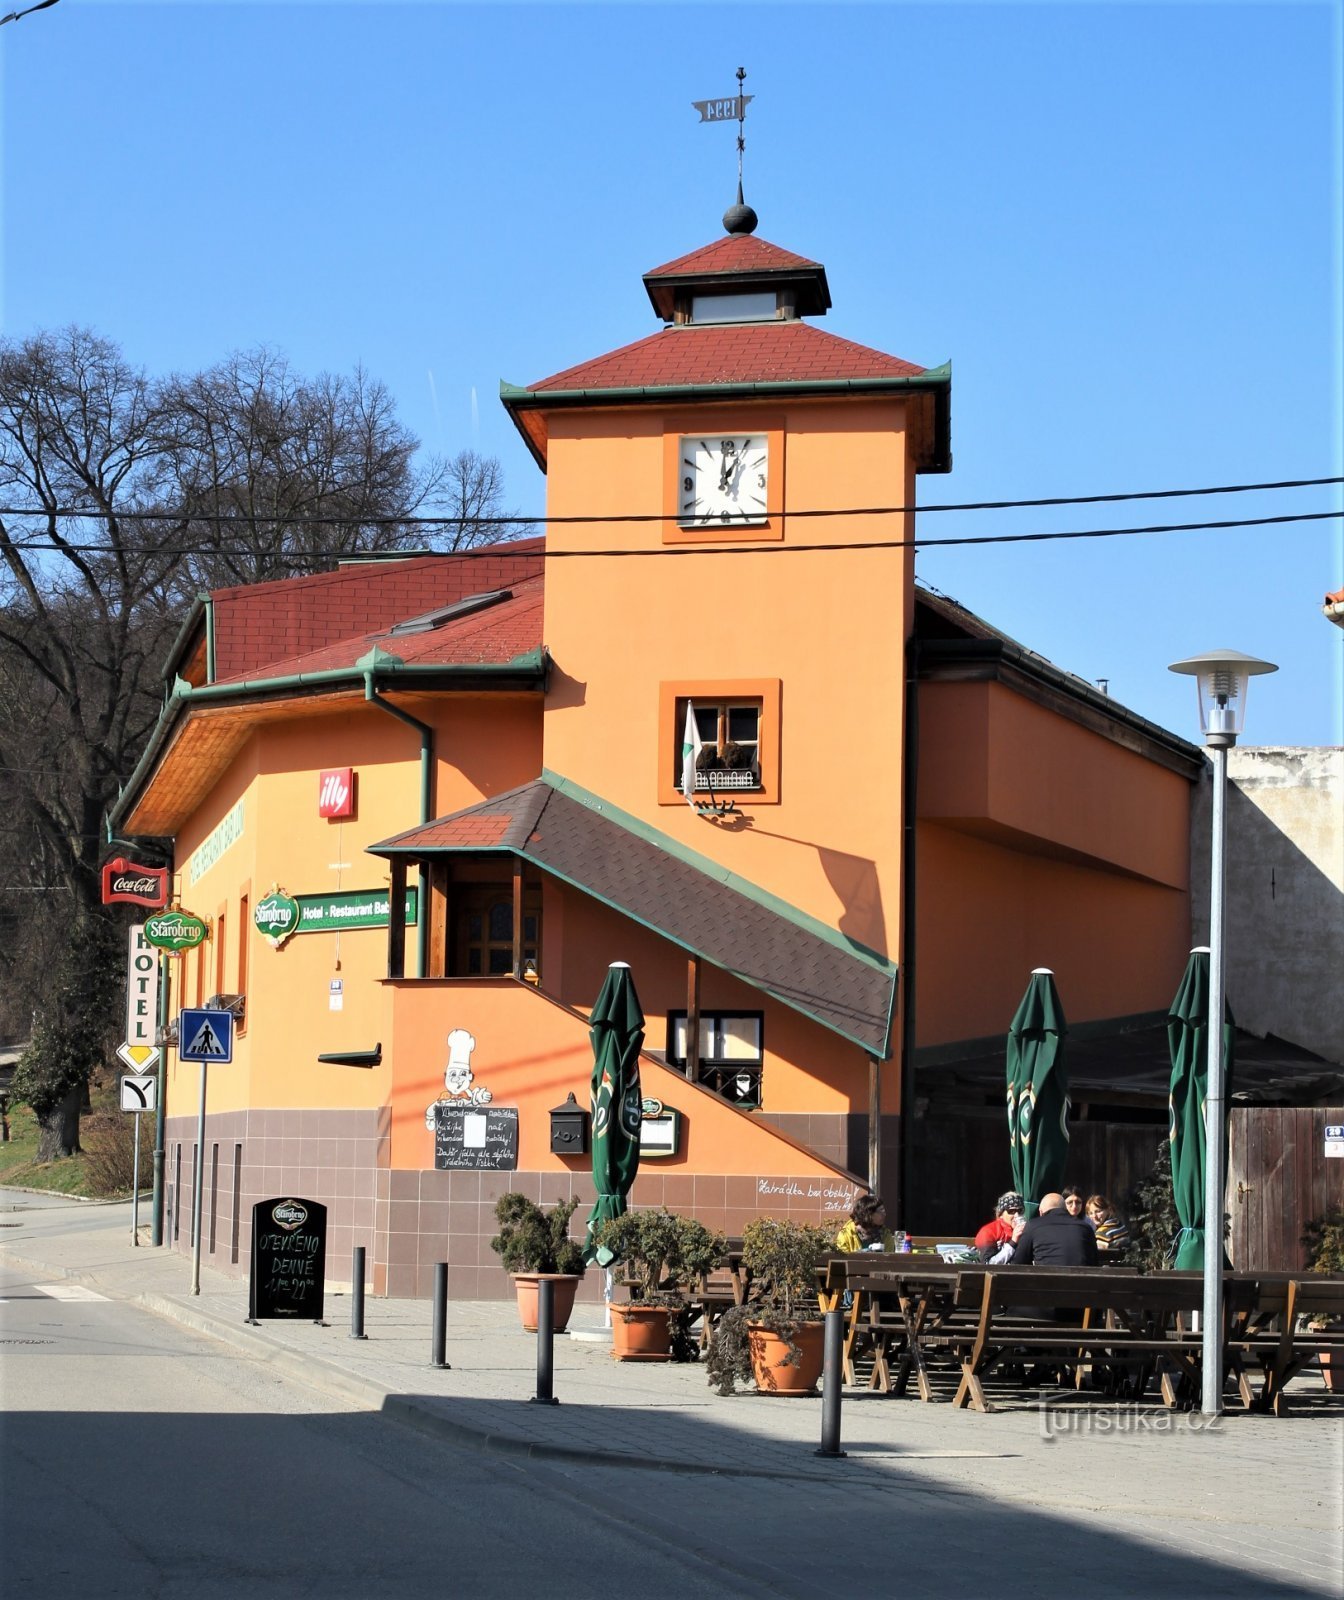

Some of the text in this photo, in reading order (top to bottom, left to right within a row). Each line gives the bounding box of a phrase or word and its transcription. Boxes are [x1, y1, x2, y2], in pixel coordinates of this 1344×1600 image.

[720, 440, 735, 457] 12
[684, 477, 694, 492] 9
[758, 474, 766, 488] 3
[320, 776, 348, 813] illy
[255, 900, 292, 930] Starobrno
[303, 906, 324, 920] Hotel
[329, 903, 373, 918] Restaurant
[150, 918, 201, 944] Starobrno
[134, 932, 153, 1038] HOTEL
[275, 1207, 305, 1222] Starobrno
